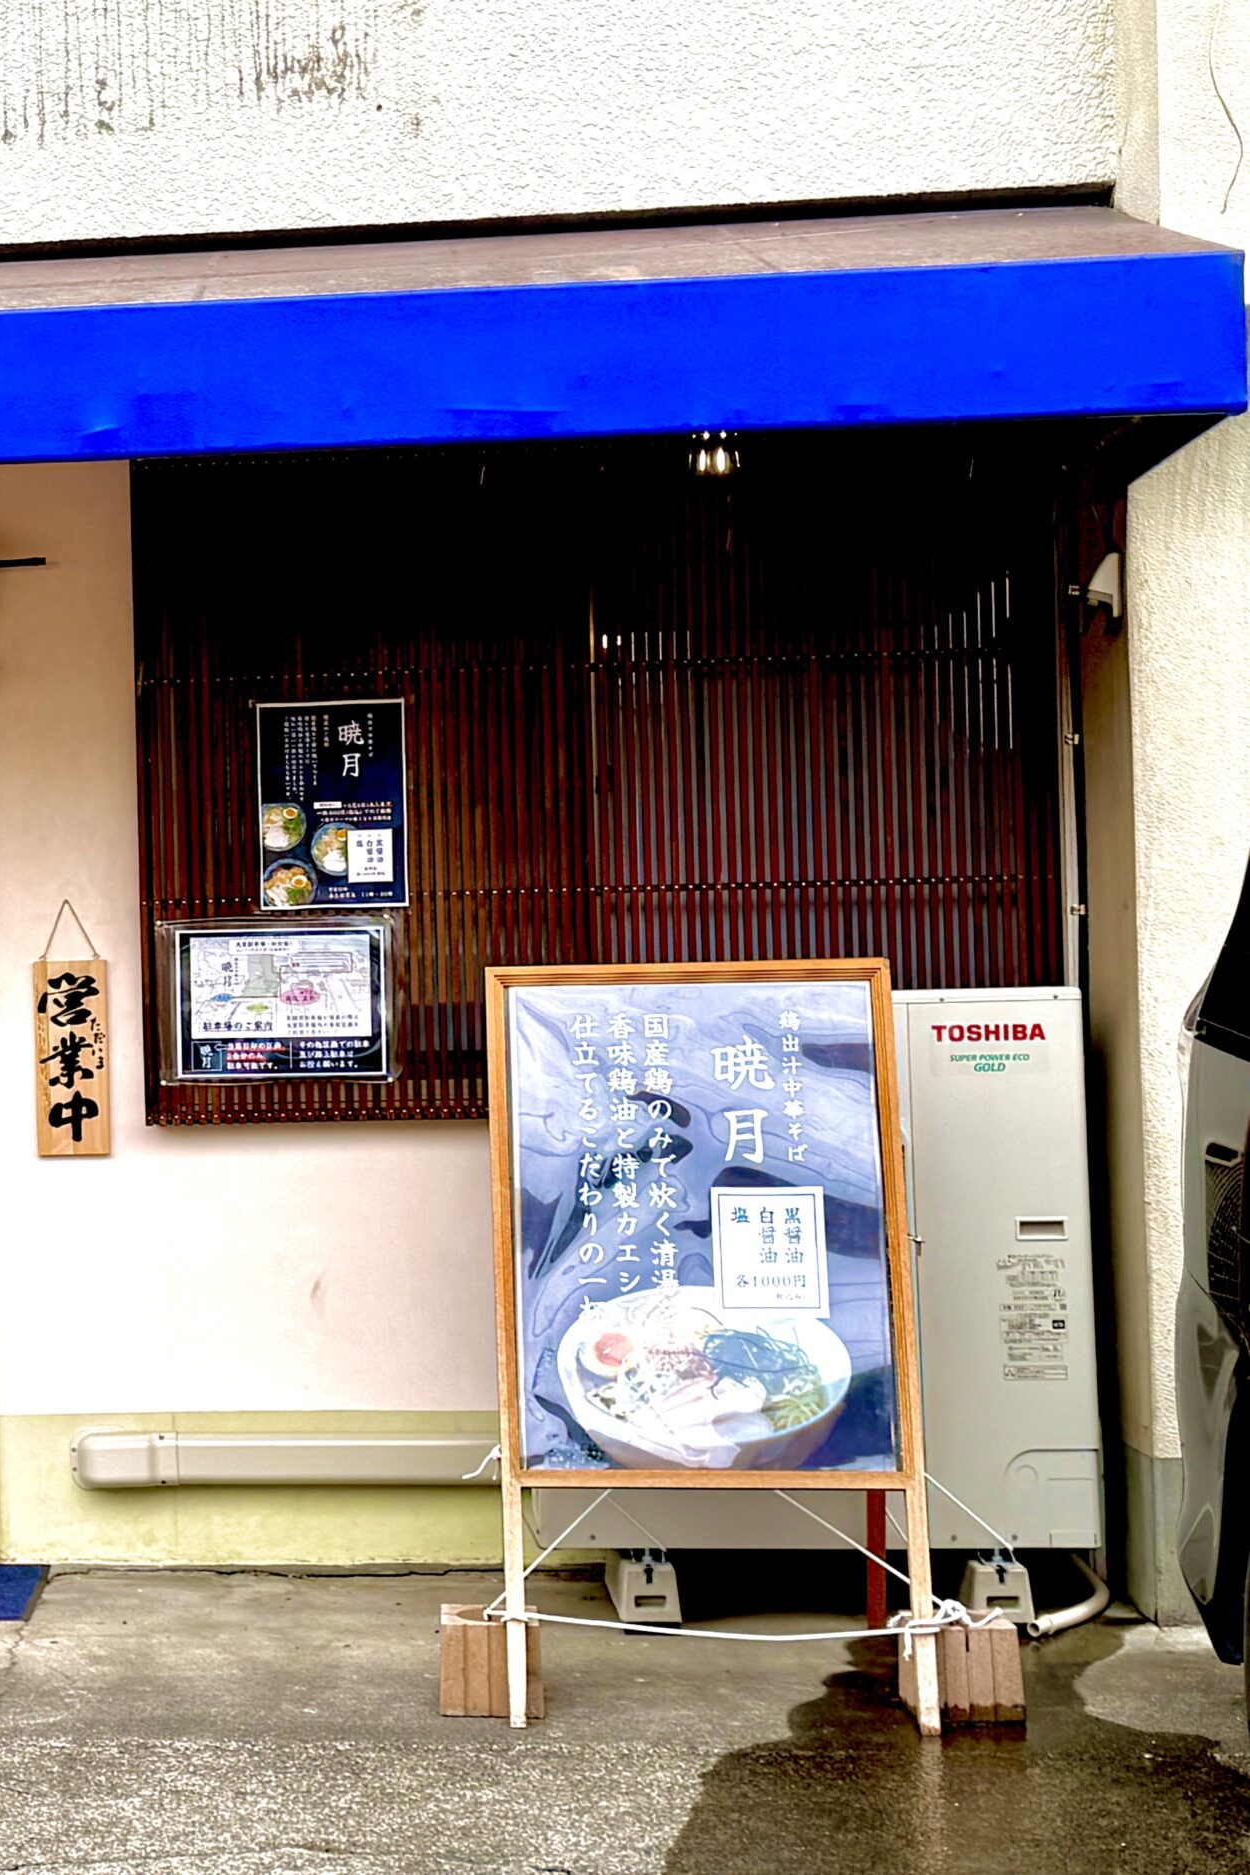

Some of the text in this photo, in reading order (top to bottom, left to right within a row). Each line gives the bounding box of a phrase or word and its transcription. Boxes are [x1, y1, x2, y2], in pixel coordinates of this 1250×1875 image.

[338, 720, 365, 777] 暁月
[37, 971, 100, 1143] 営業中
[90, 1017, 106, 1070] ただいま
[931, 1023, 1046, 1042] TOSHIBA
[950, 1053, 1030, 1062] SUPER POWER ECO
[778, 1010, 808, 1162] 鶏出汁中華そば
[974, 1062, 1006, 1072] GOLD
[710, 1034, 775, 1164] 暁月
[642, 1013, 680, 1324] 国産鶏のみで炊く清湯
[731, 1206, 751, 1224] 塩
[736, 1274, 806, 1288] 各1000円
